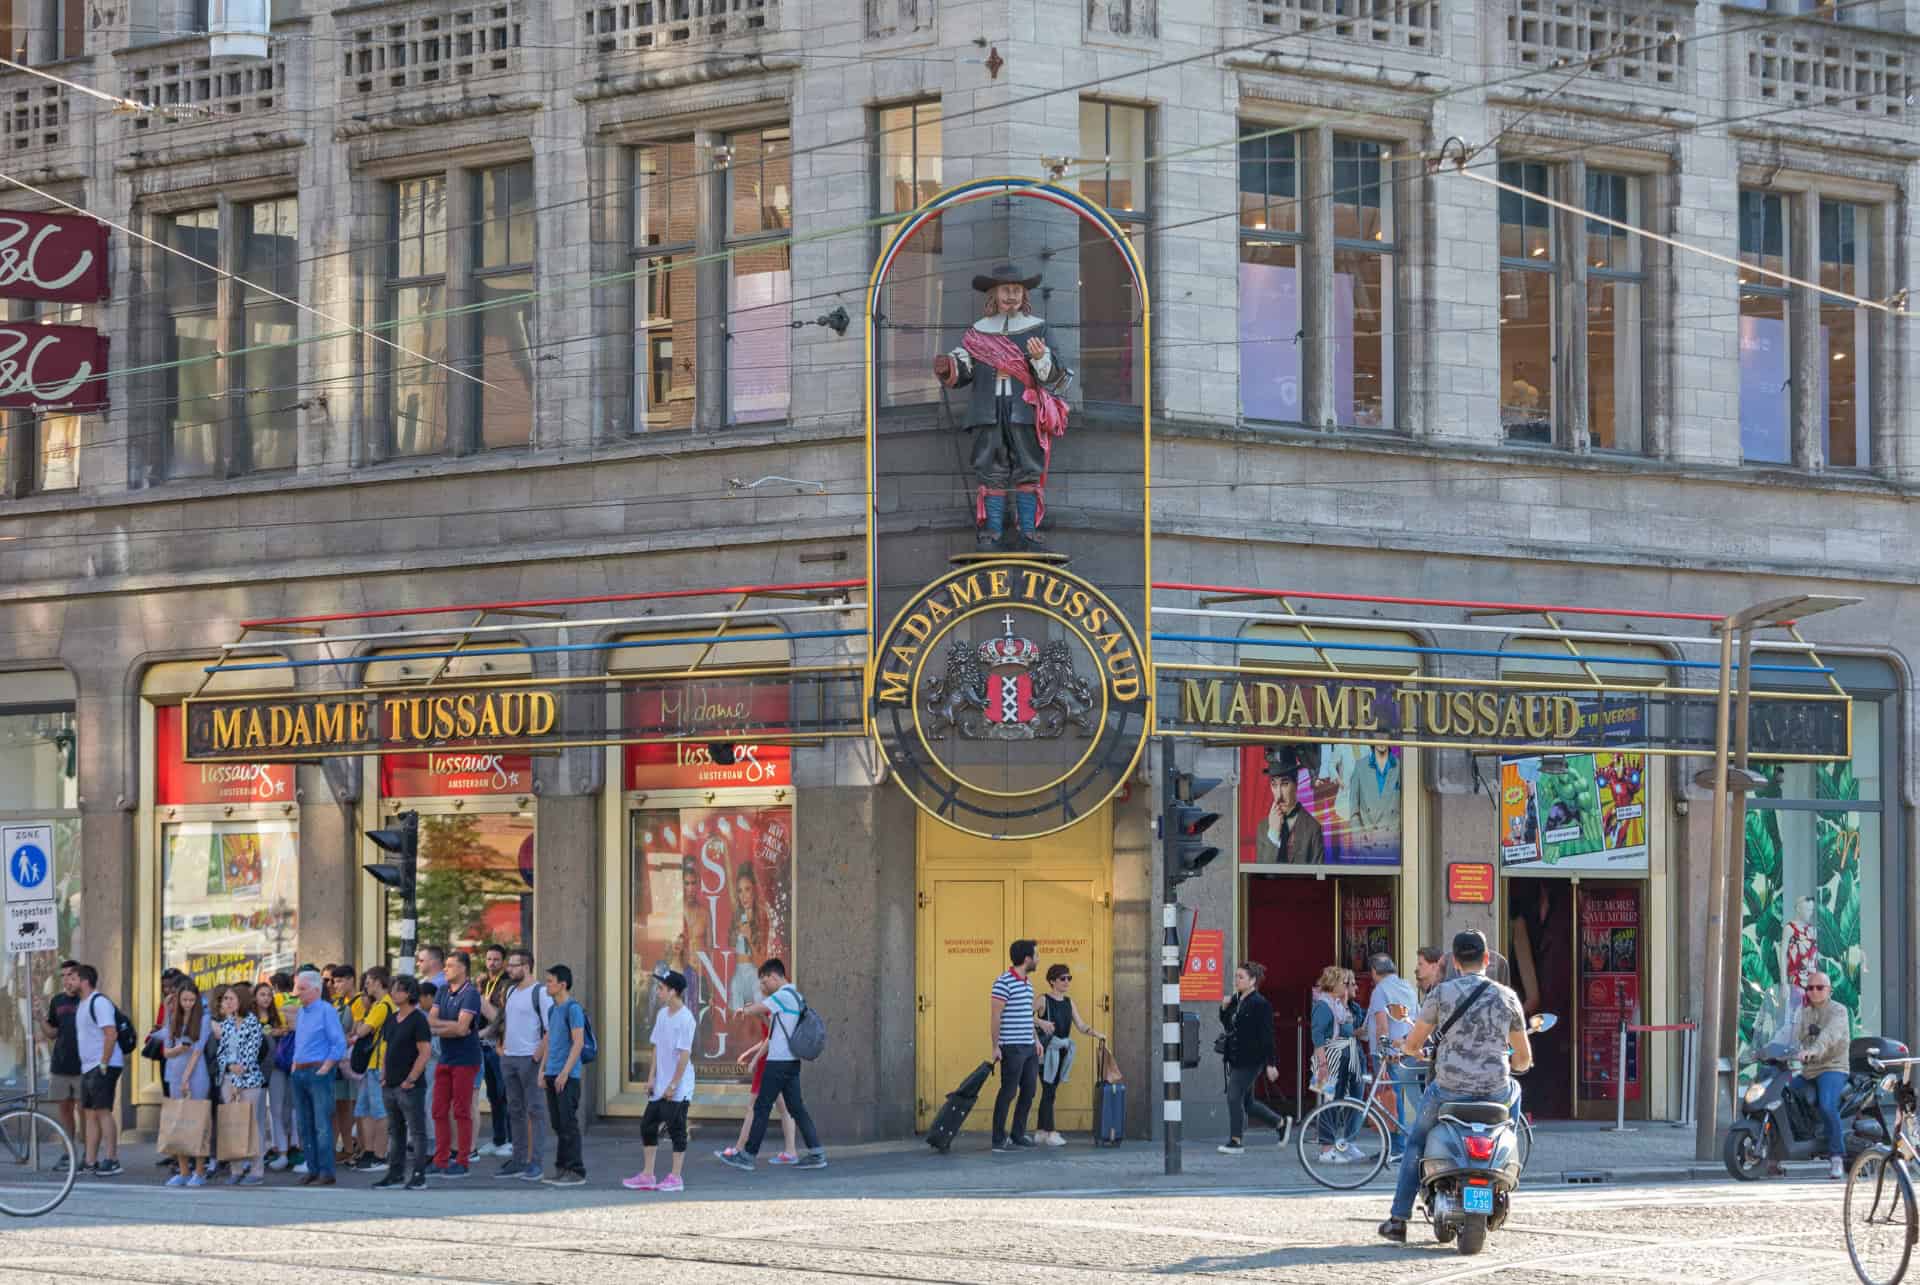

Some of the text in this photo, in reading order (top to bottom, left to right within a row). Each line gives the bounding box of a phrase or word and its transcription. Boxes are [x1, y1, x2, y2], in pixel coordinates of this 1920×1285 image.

[880, 570, 1140, 704] MADAME TUSSAUD
[211, 692, 555, 750] MADAME TUSSAUD
[1184, 678, 1580, 738] MADAME TUSSAUD
[677, 742, 762, 782] Tussds
[699, 769, 743, 781] AMSTERDAM
[448, 778, 489, 790] AMSTERDAM
[16, 830, 40, 840] ZONE
[11, 906, 53, 920] toegestaan
